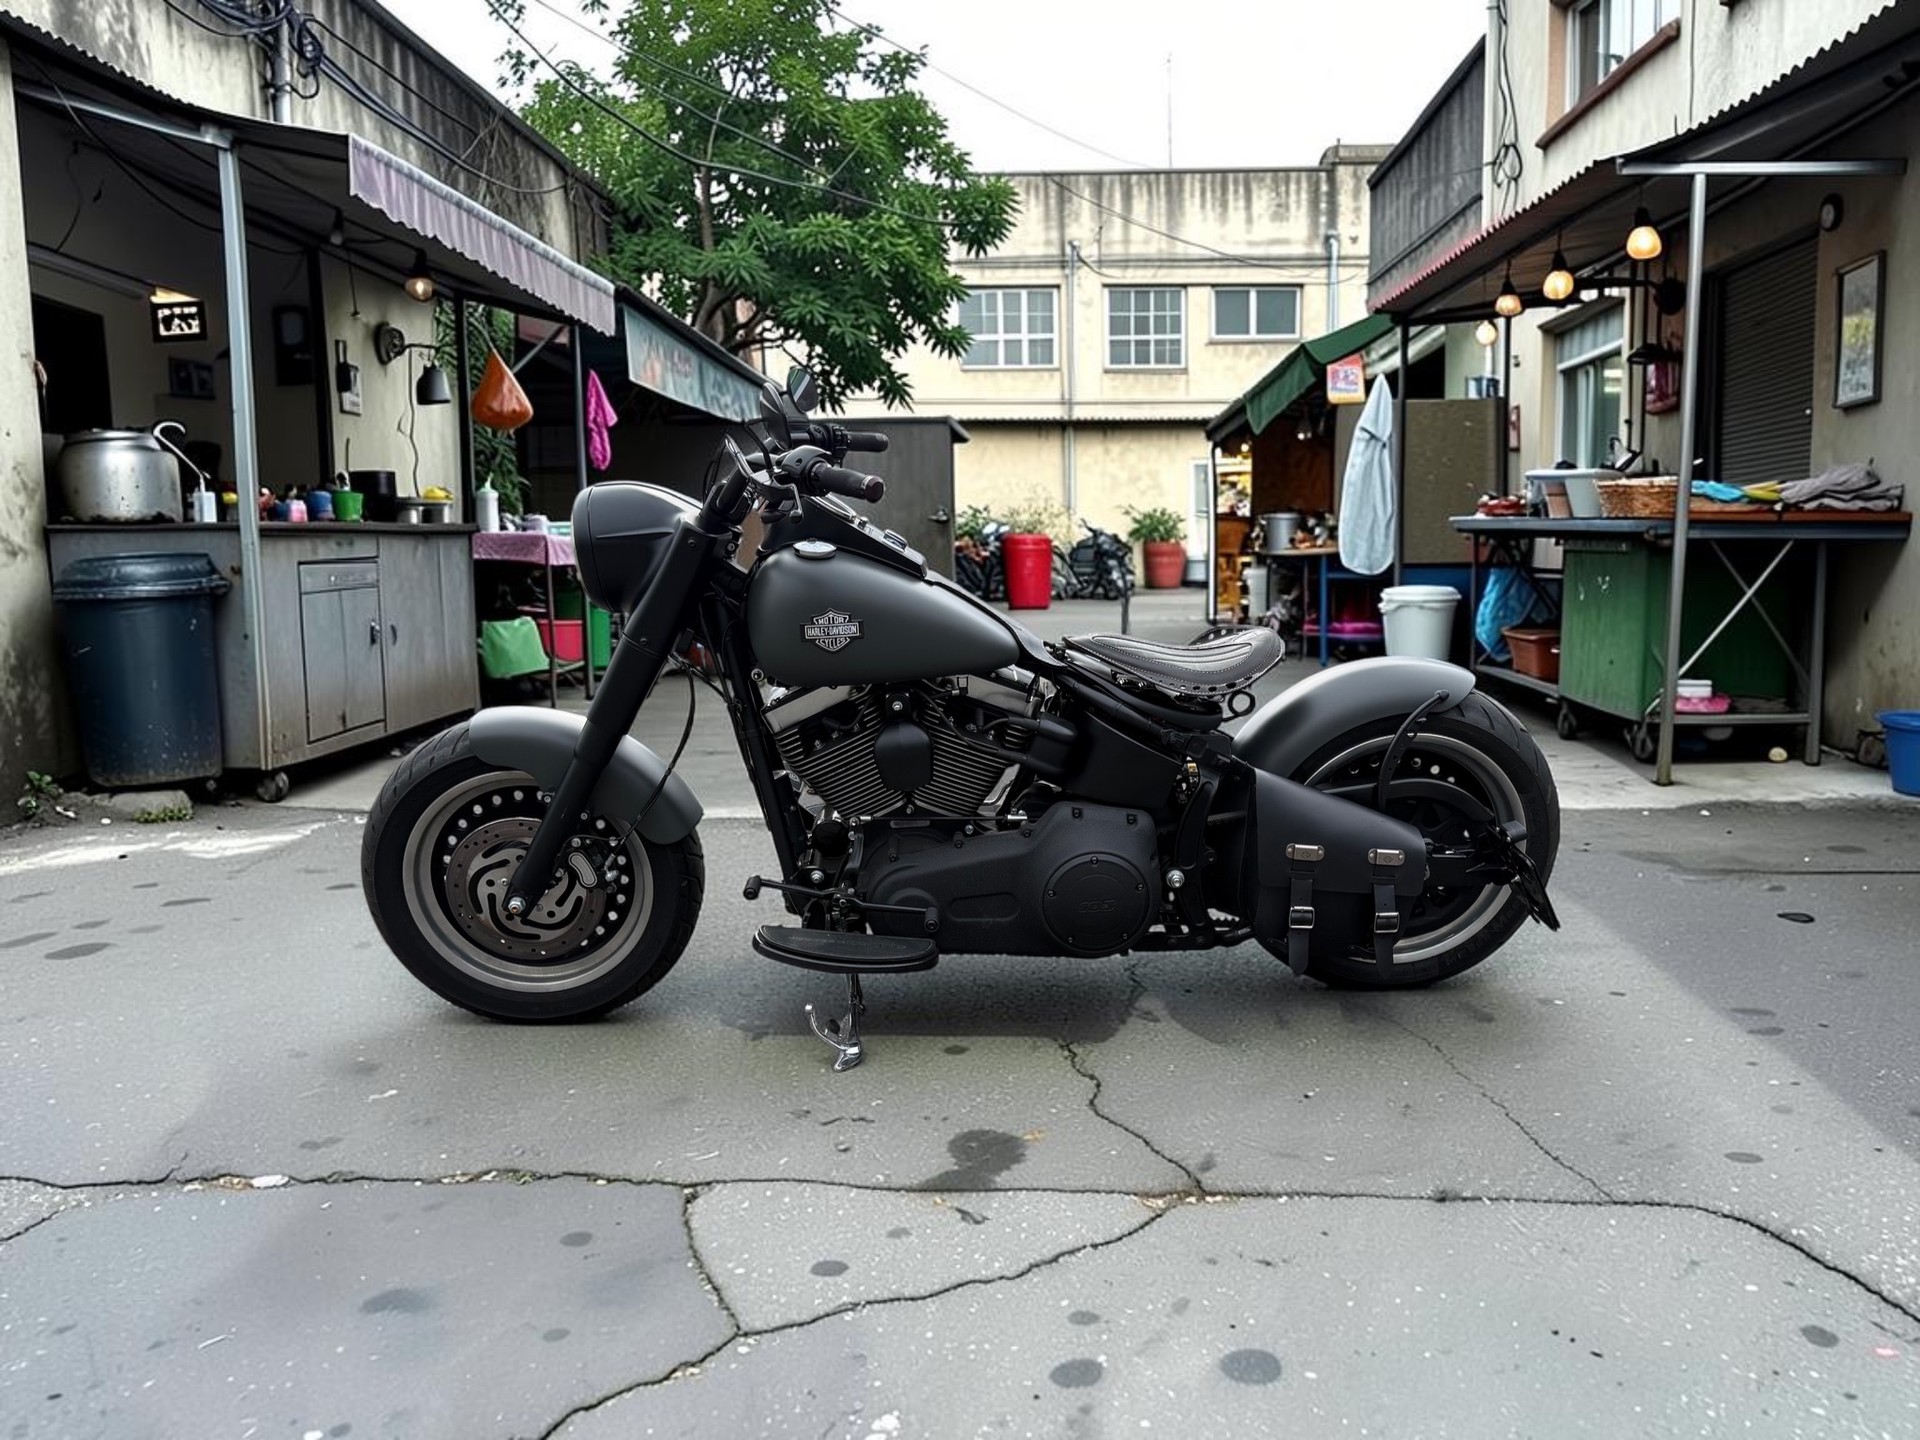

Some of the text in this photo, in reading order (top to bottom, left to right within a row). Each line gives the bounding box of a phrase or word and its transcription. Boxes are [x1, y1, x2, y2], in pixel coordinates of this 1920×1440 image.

[818, 614, 844, 624] MOTOR
[807, 625, 857, 636] HARLEY-DAVIDSON
[819, 637, 845, 649] CYCLES
